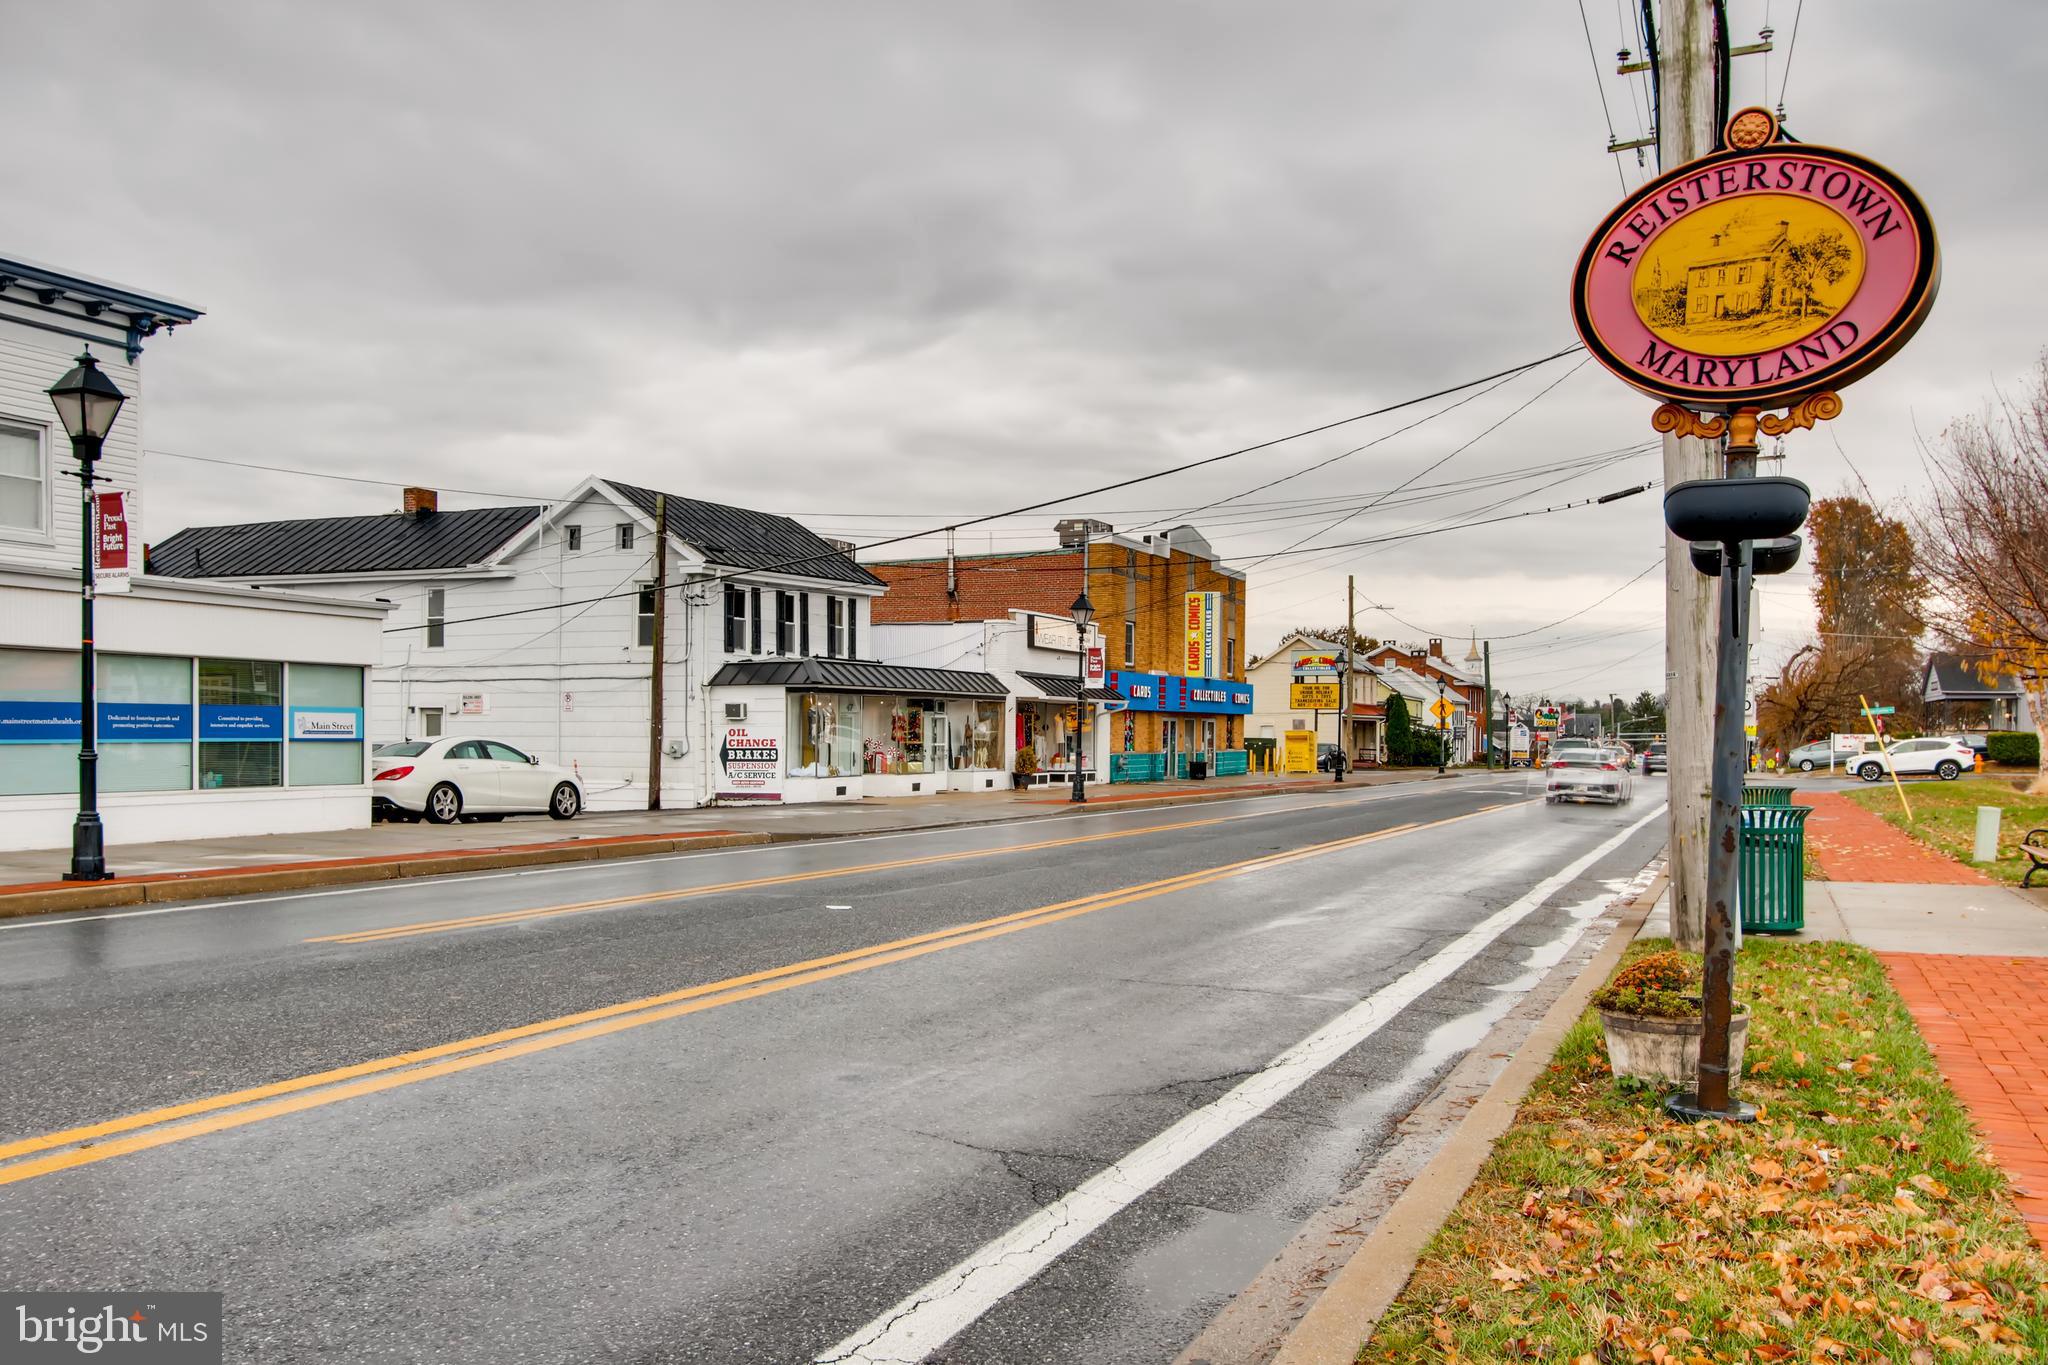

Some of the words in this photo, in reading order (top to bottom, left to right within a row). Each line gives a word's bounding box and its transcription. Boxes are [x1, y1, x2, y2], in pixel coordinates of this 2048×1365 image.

[1605, 161, 1902, 268] REISTERSTOWN
[1636, 320, 1859, 387] MARYLAND
[103, 513, 123, 522] Proud
[103, 522, 116, 531] Past
[103, 534, 123, 544] Bright
[103, 543, 124, 551] Future
[1188, 597, 1201, 631] COMICS
[1188, 641, 1200, 671] CARDS
[1131, 685, 1151, 698] CARDS
[1192, 689, 1227, 703] COLLECTIBLES
[1233, 693, 1250, 704] COMICS
[311, 721, 331, 730] Main
[331, 721, 353, 730] Street
[728, 728, 748, 737] OIL
[728, 738, 776, 747] CHANGE
[727, 750, 777, 760] BRAKES
[728, 771, 743, 779] A/C
[744, 771, 776, 779] SERVICE
